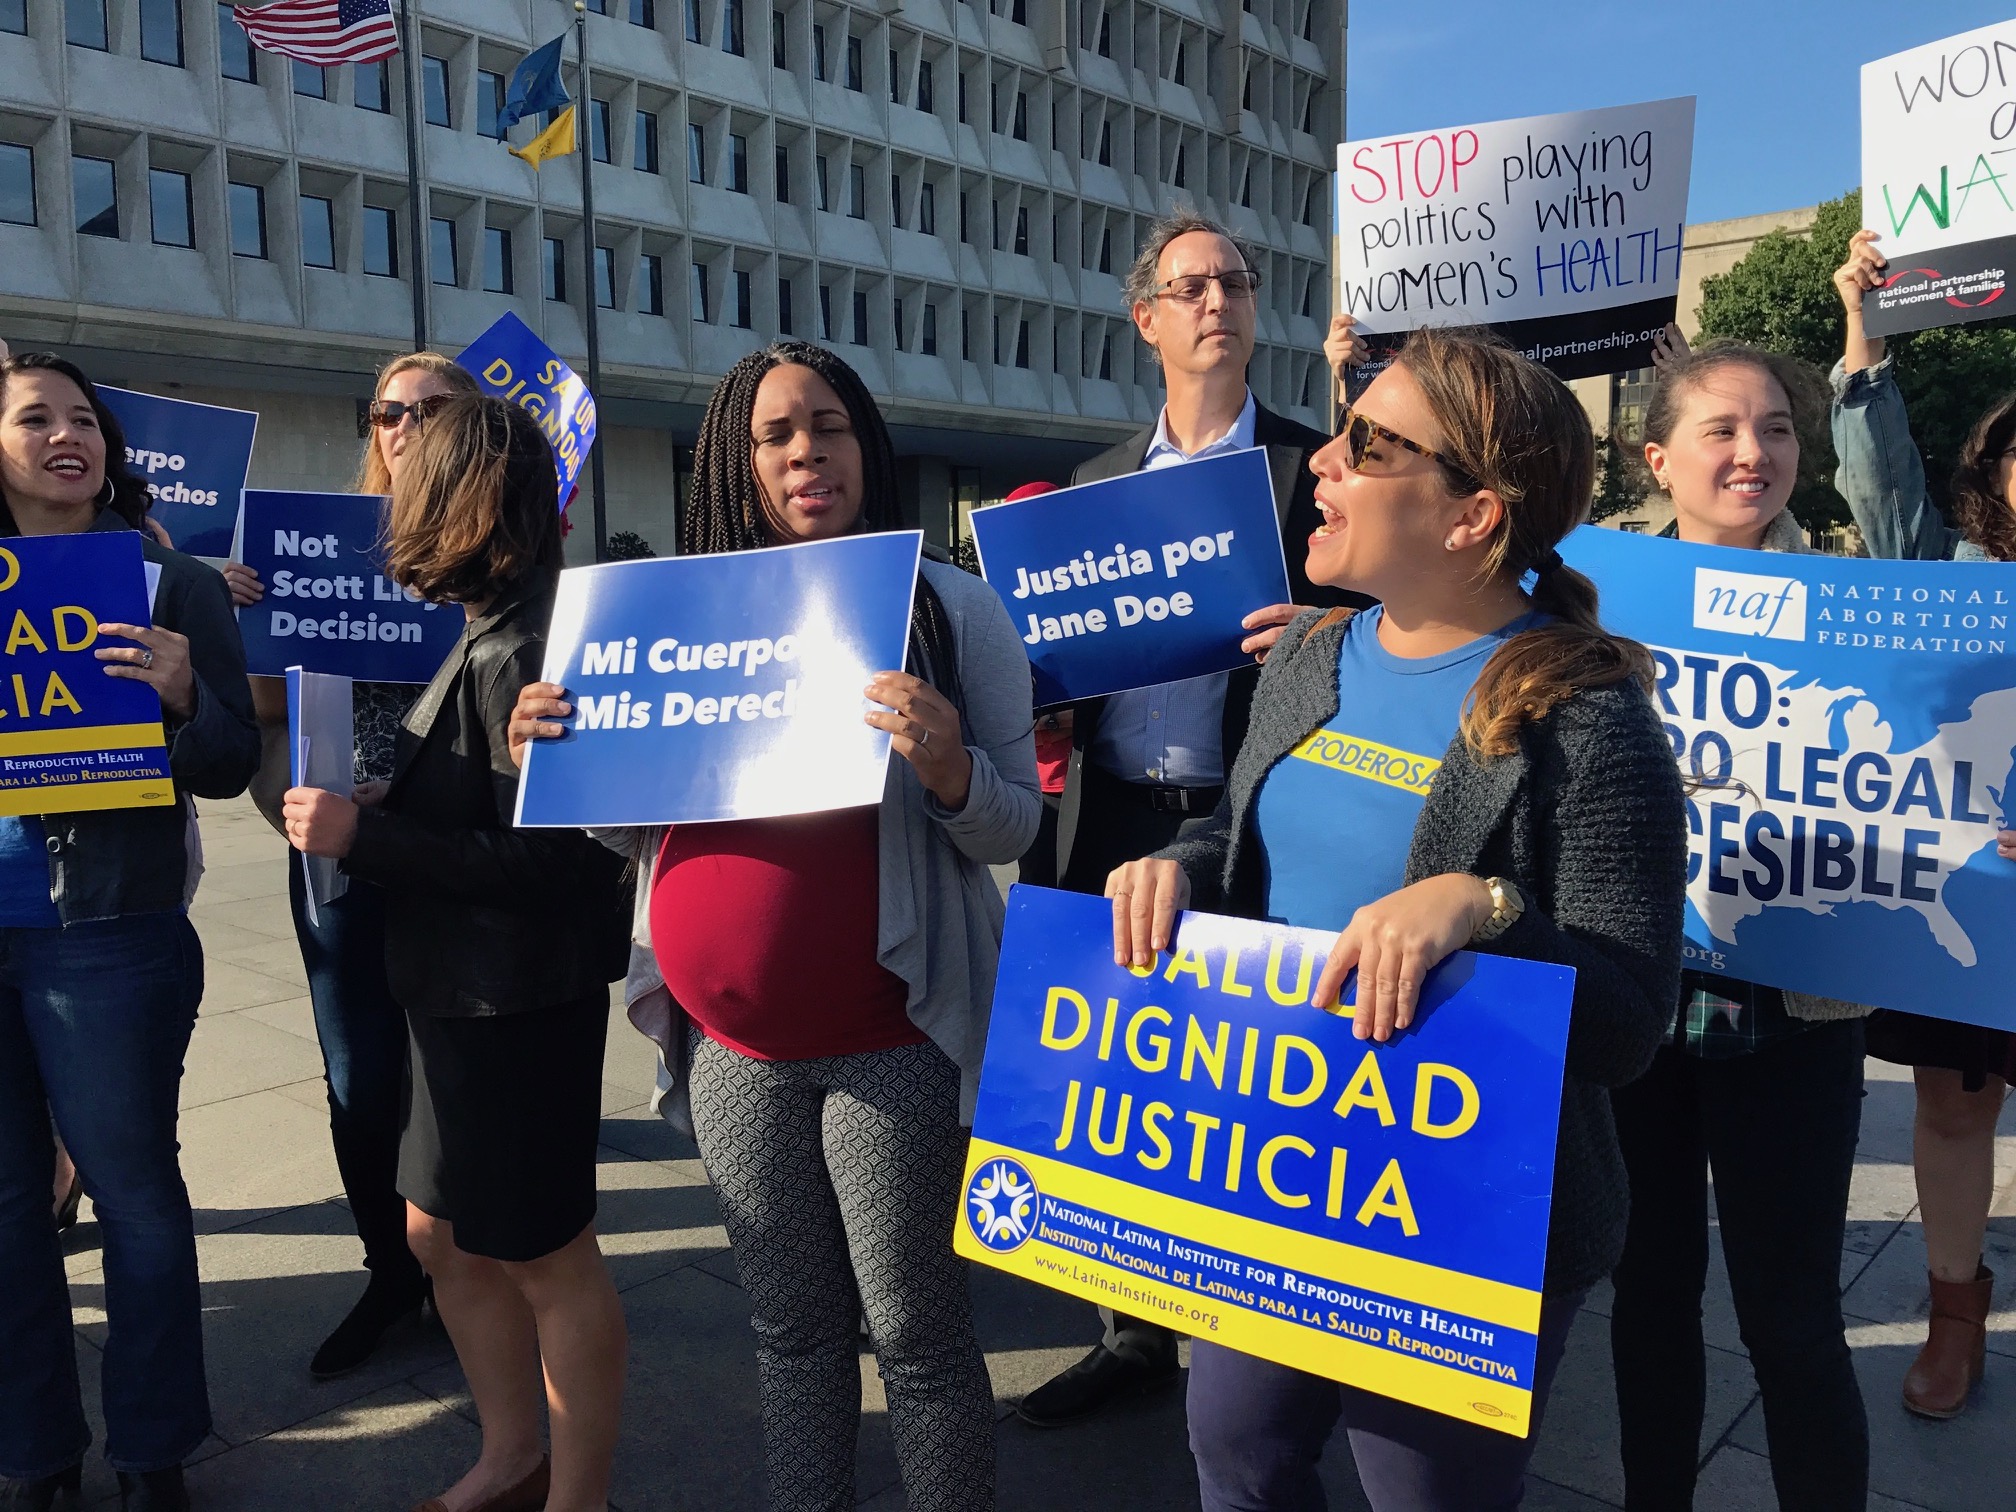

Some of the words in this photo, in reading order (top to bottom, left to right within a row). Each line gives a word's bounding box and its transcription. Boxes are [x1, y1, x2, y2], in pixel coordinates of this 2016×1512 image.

[1351, 129, 1479, 204] STOP
[1503, 131, 1652, 204] playing
[1883, 147, 2016, 238] WA
[1361, 202, 1496, 268] politics
[1535, 184, 1625, 232] with
[1879, 280, 1928, 298] national
[1931, 268, 2005, 290] partnership
[1879, 298, 1897, 309] for
[1900, 291, 1944, 306] women
[1945, 287, 1956, 297] &
[1959, 280, 2005, 295] families
[274, 529, 339, 559] Not
[1012, 543, 1154, 599] Justicia
[1161, 530, 1234, 579] por
[271, 570, 364, 600] Scott
[1707, 579, 1807, 638] naf
[1819, 583, 2009, 605] NATIONAL
[5, 605, 98, 656] AD
[270, 611, 422, 643] Decision
[1023, 608, 1107, 645] Jane
[1113, 591, 1194, 627] Doe
[1817, 607, 2008, 630] ABORTION
[1817, 630, 2006, 654] FEDERATION
[581, 637, 638, 676] Mi
[647, 634, 801, 676] Cuerpo
[575, 691, 652, 730] Mis
[4, 757, 94, 771] REPRODUCTIVE
[98, 752, 144, 764] HEALTH
[23, 776, 38, 785] LA
[41, 771, 78, 784] SALUD
[81, 768, 162, 780] REPRODUCTIVA
[1765, 741, 1990, 824] LEGAL
[1039, 986, 1481, 1139] DIGNIDAD
[1055, 1080, 1420, 1238] JUSTICIA
[1035, 1255, 1219, 1331] www.LatinaInstitute.org
[1043, 1198, 1108, 1235] NATIONAL
[1112, 1221, 1162, 1252] LATINA
[1167, 1238, 1241, 1276] INSTITUTE
[1246, 1266, 1277, 1287] FOR
[1283, 1272, 1413, 1325] REPRODUCTIVE
[1420, 1310, 1495, 1347] HEALTH
[1038, 1221, 1099, 1255] INSTITUTO
[1101, 1241, 1169, 1280] NACIONAL
[1173, 1269, 1191, 1286] DE
[1195, 1272, 1255, 1306] LATINAS
[1259, 1296, 1297, 1319] PARA
[1302, 1309, 1322, 1326] LA
[1327, 1311, 1382, 1342] SALUD
[1387, 1328, 1518, 1382] REPRODUCTIVA
